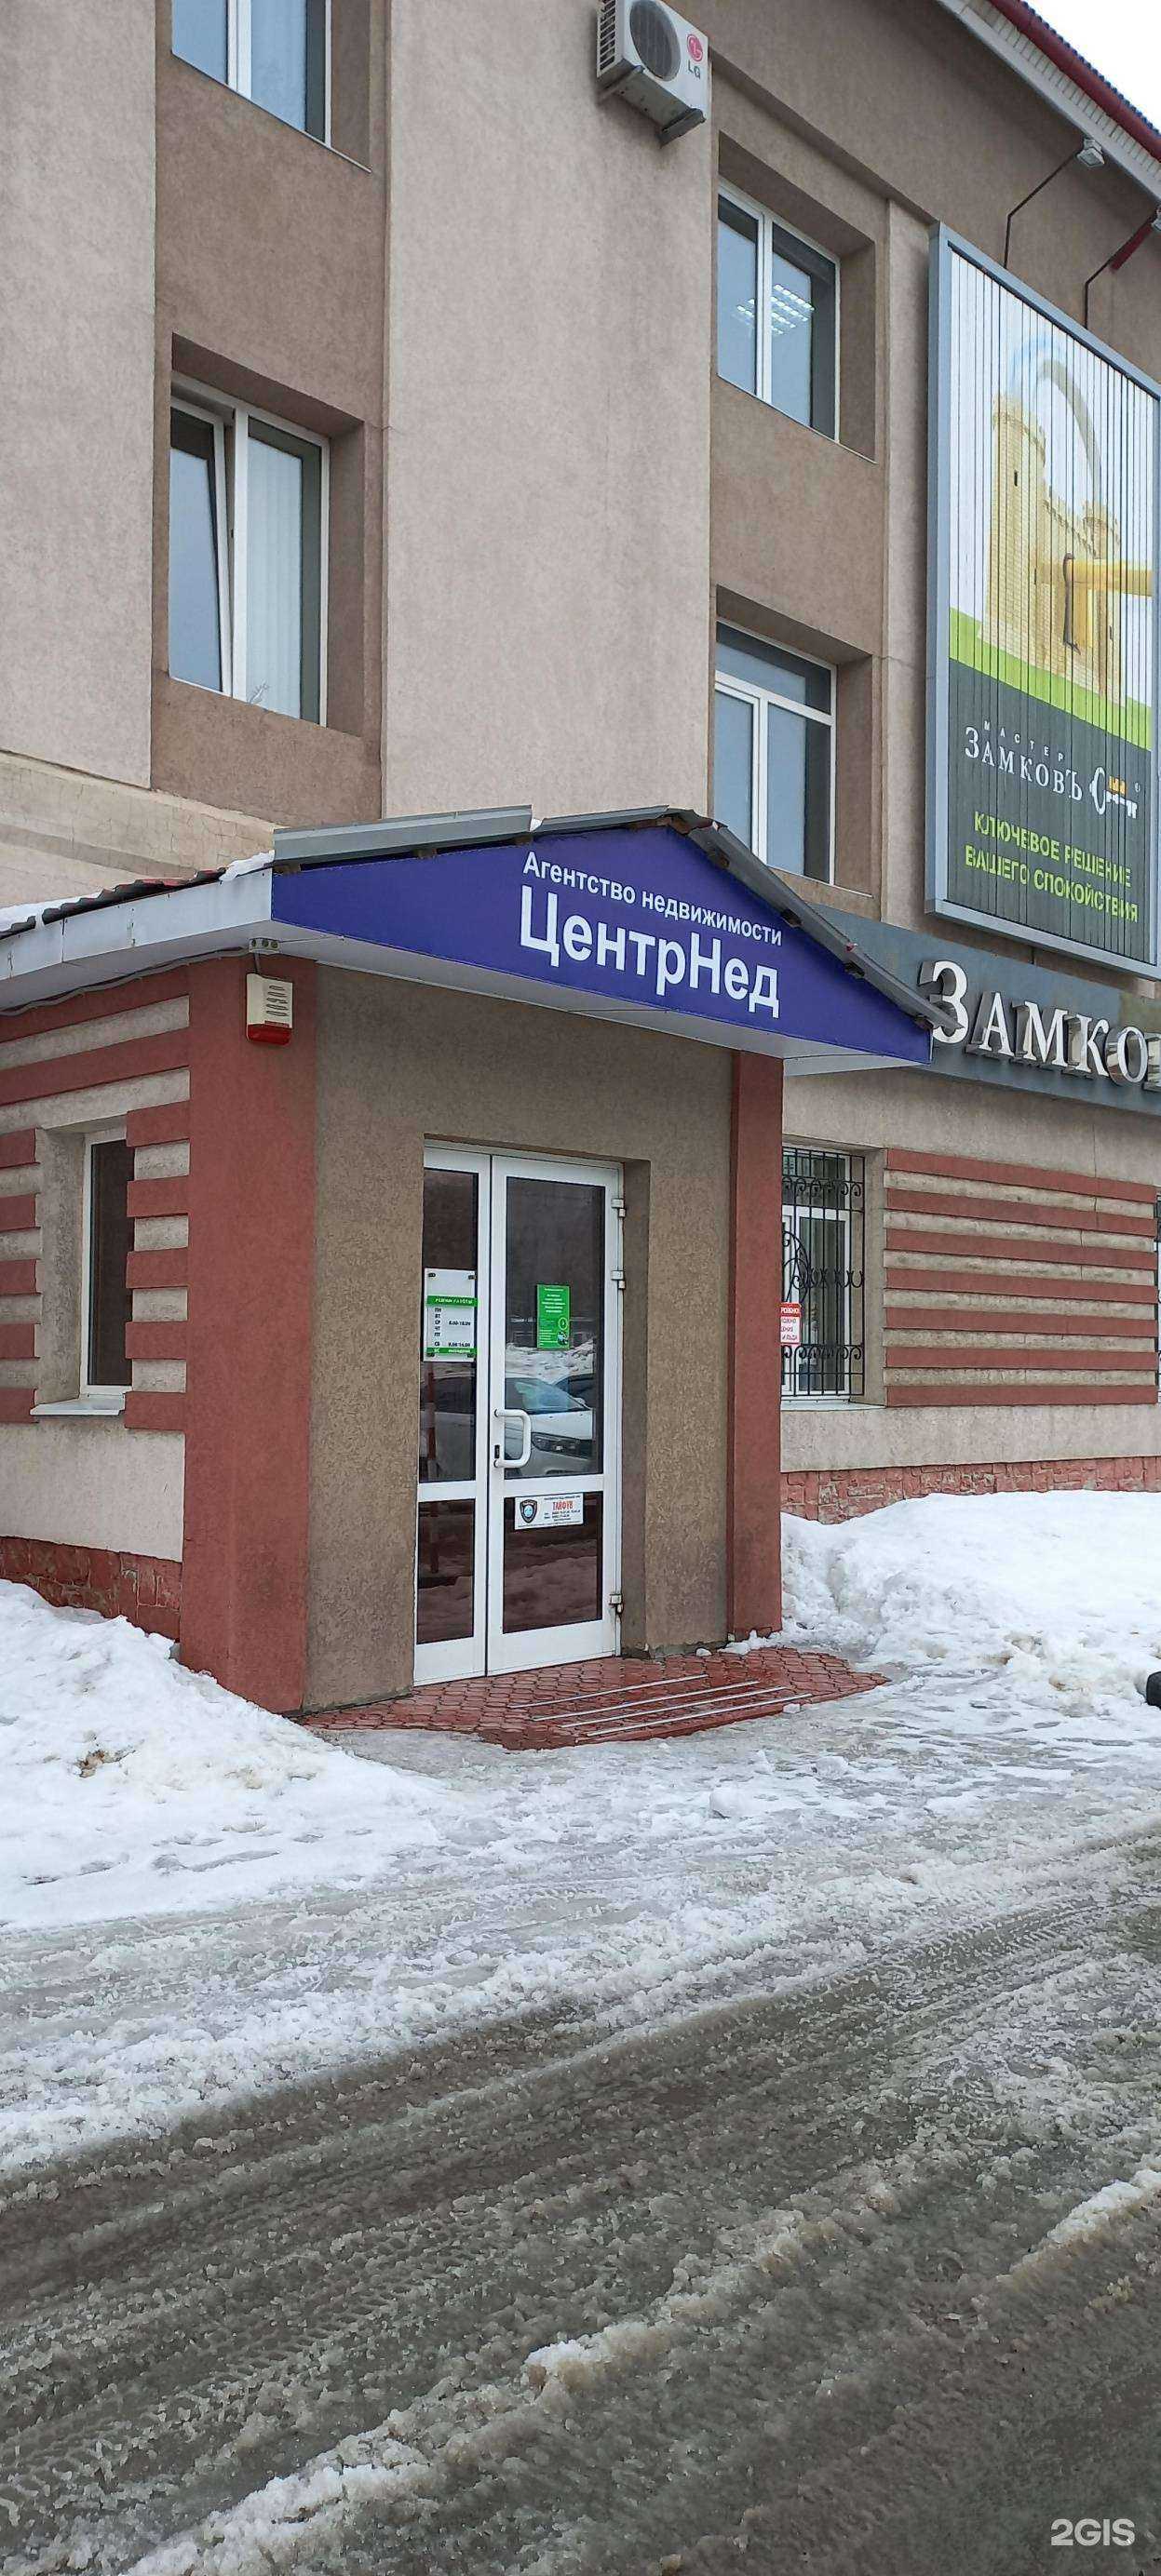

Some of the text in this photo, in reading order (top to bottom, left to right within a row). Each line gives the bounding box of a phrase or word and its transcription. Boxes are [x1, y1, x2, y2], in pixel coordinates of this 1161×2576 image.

[687, 60, 701, 79] LG
[965, 726, 1083, 801] ЗАМКОВЪ
[983, 719, 1065, 762] МАСТЕР
[965, 845, 1140, 923] ВАШЕГО СПОКОЙСТВИЯ
[974, 811, 1132, 887] КЛЮЧЕВОЕ РЕШЕНИЕ
[523, 851, 782, 946] Агентство недвижимости
[520, 884, 780, 1019] ЦентрНед
[931, 959, 1161, 1087] ЗАМКО
